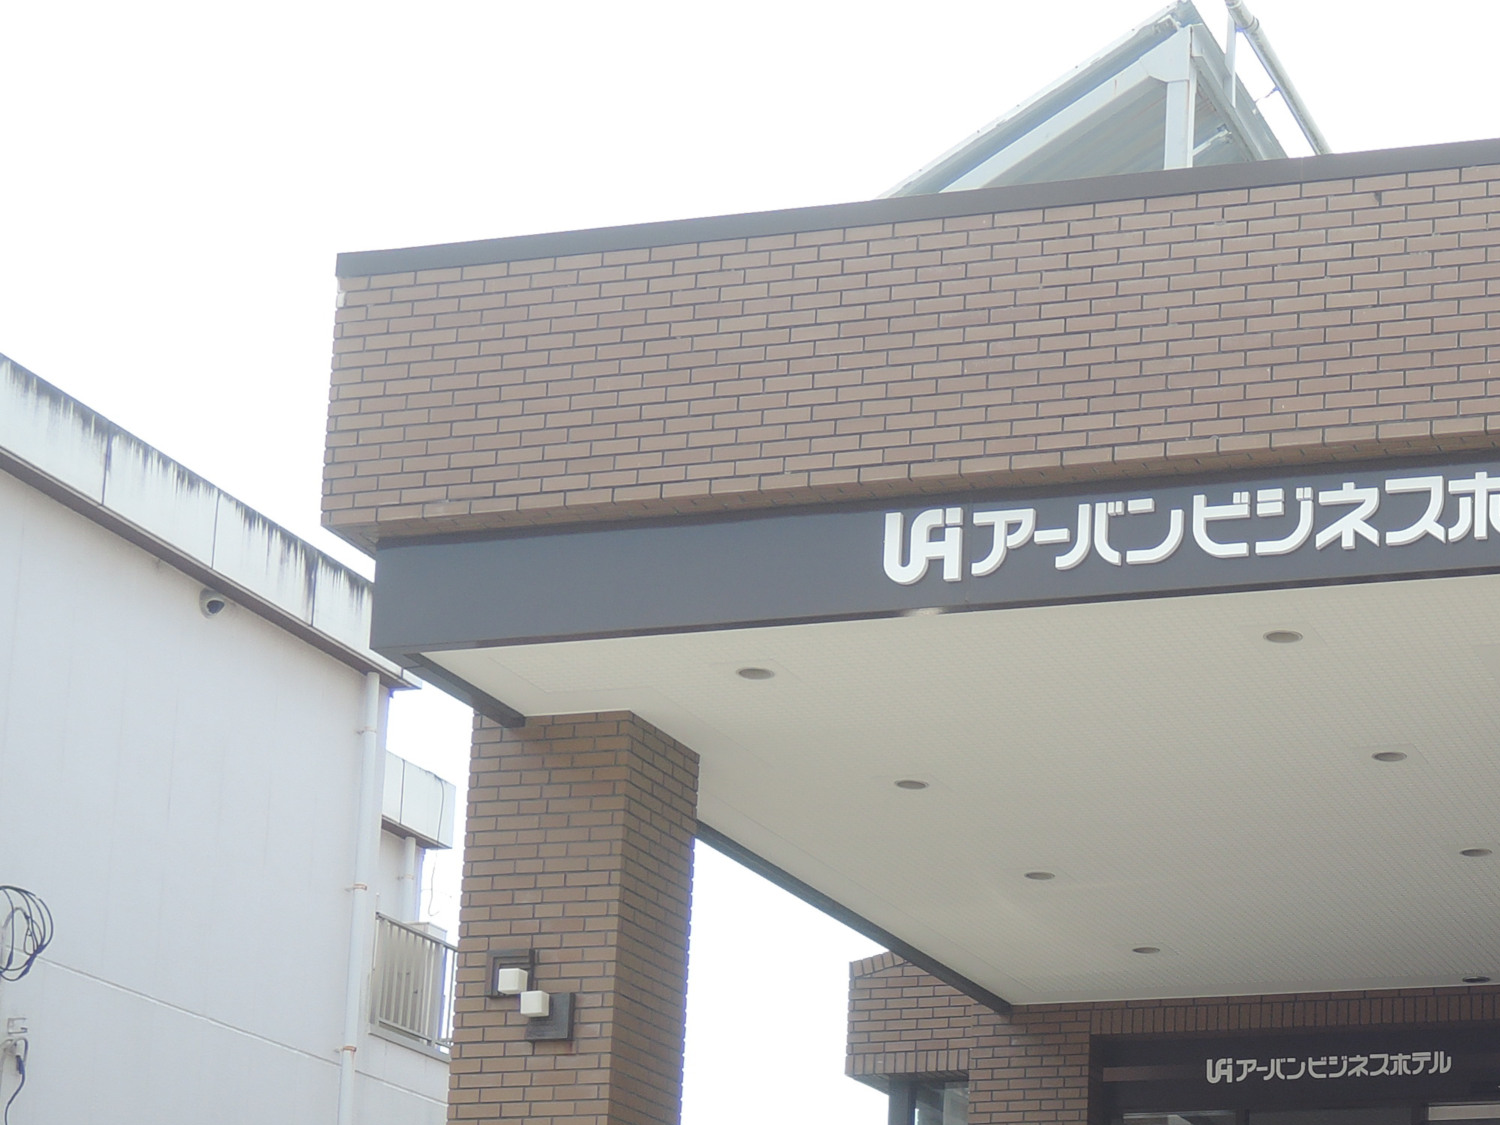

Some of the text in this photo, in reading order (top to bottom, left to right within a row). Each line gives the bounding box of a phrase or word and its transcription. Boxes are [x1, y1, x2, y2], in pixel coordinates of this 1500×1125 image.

[1236, 1051, 1452, 1082] アーバンビジネスホテル
